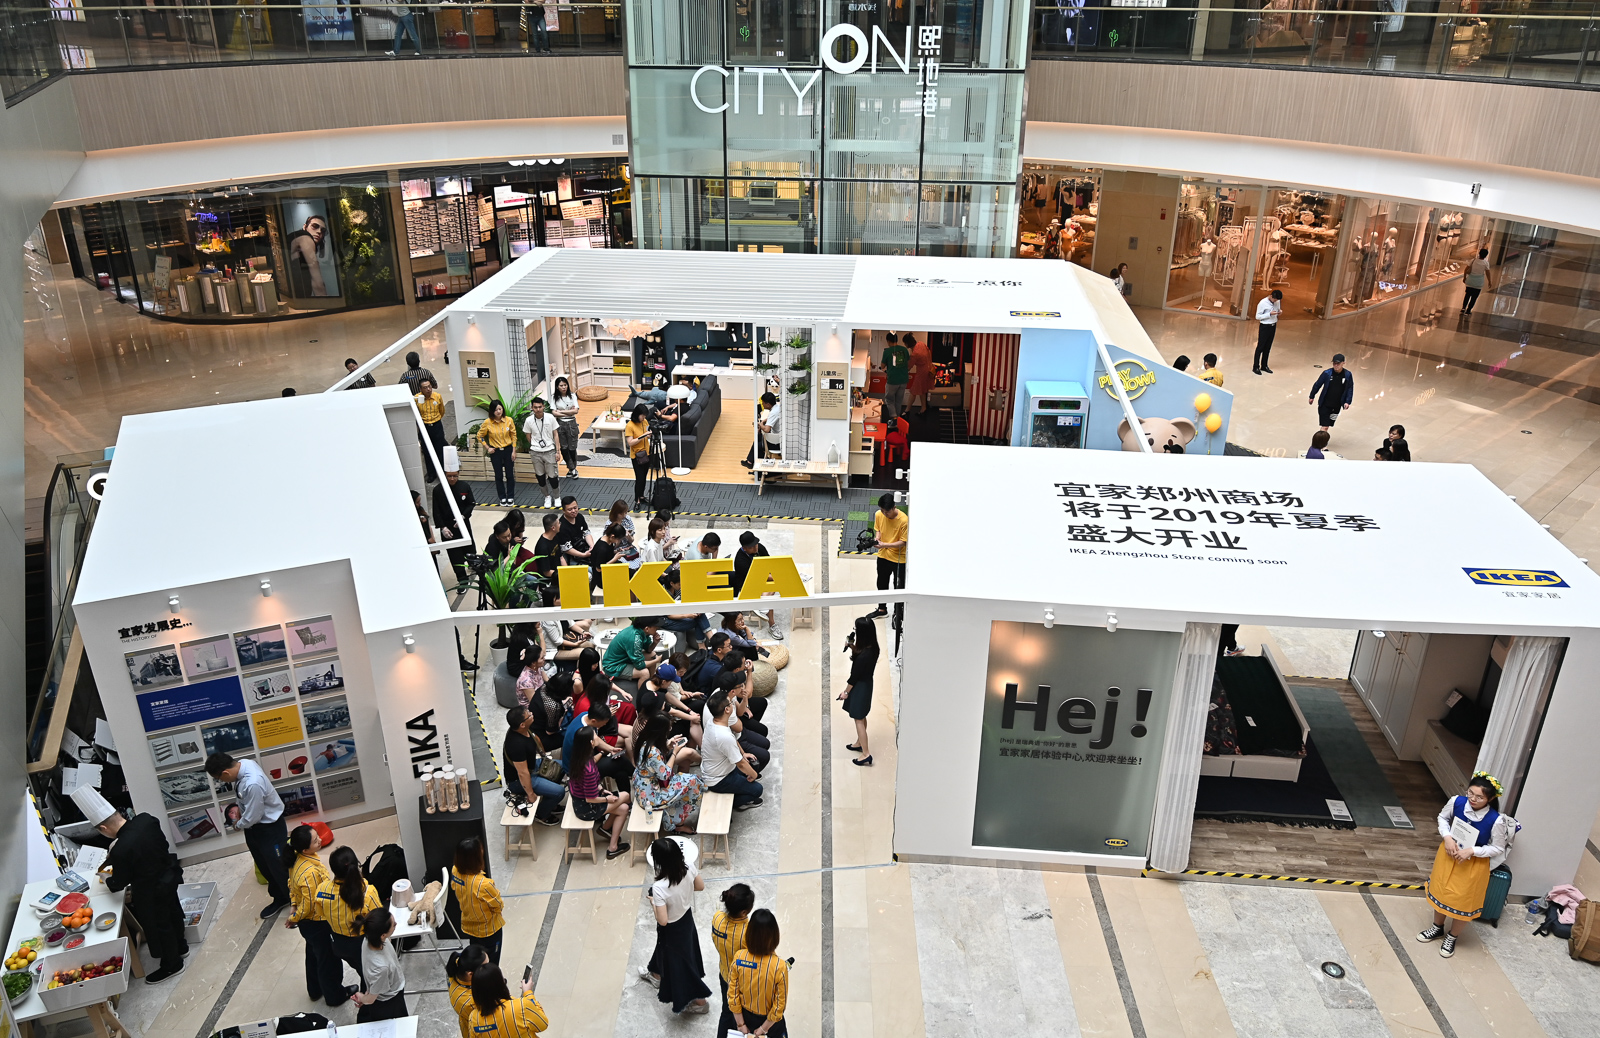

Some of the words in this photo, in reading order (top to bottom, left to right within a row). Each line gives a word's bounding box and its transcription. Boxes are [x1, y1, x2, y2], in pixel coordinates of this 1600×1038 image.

[821, 23, 912, 74] ON
[690, 65, 822, 116] CITY
[914, 25, 942, 118] 熙地港
[1053, 482, 1305, 508] 宜家郑州商场
[1063, 500, 1382, 532] 将于2019年夏季
[1066, 523, 1249, 551] 盛大开业
[1069, 547, 1097, 555] IKEA
[1099, 549, 1169, 559] Zhengzhou
[1207, 556, 1255, 565] coming
[557, 555, 809, 610] IKEA
[1475, 572, 1558, 582] IKEA
[1001, 682, 1154, 750] Hej!
